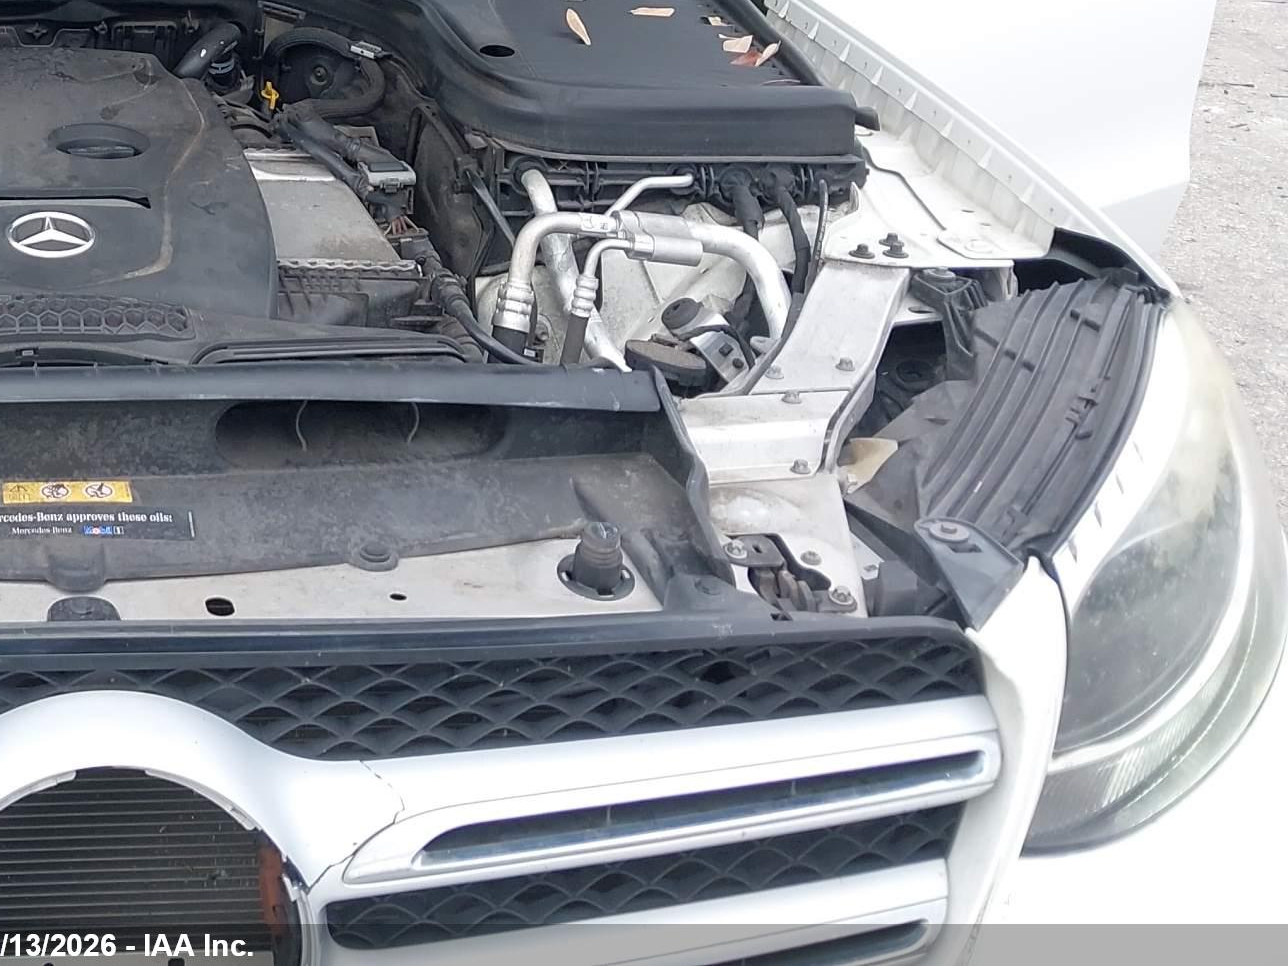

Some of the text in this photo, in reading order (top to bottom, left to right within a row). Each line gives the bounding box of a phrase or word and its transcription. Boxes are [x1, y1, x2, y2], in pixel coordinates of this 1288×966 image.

[66, 513, 115, 523] approves
[117, 512, 147, 523] these
[149, 512, 173, 523] oils:
[12, 526, 73, 535] Mercedes-Benz
